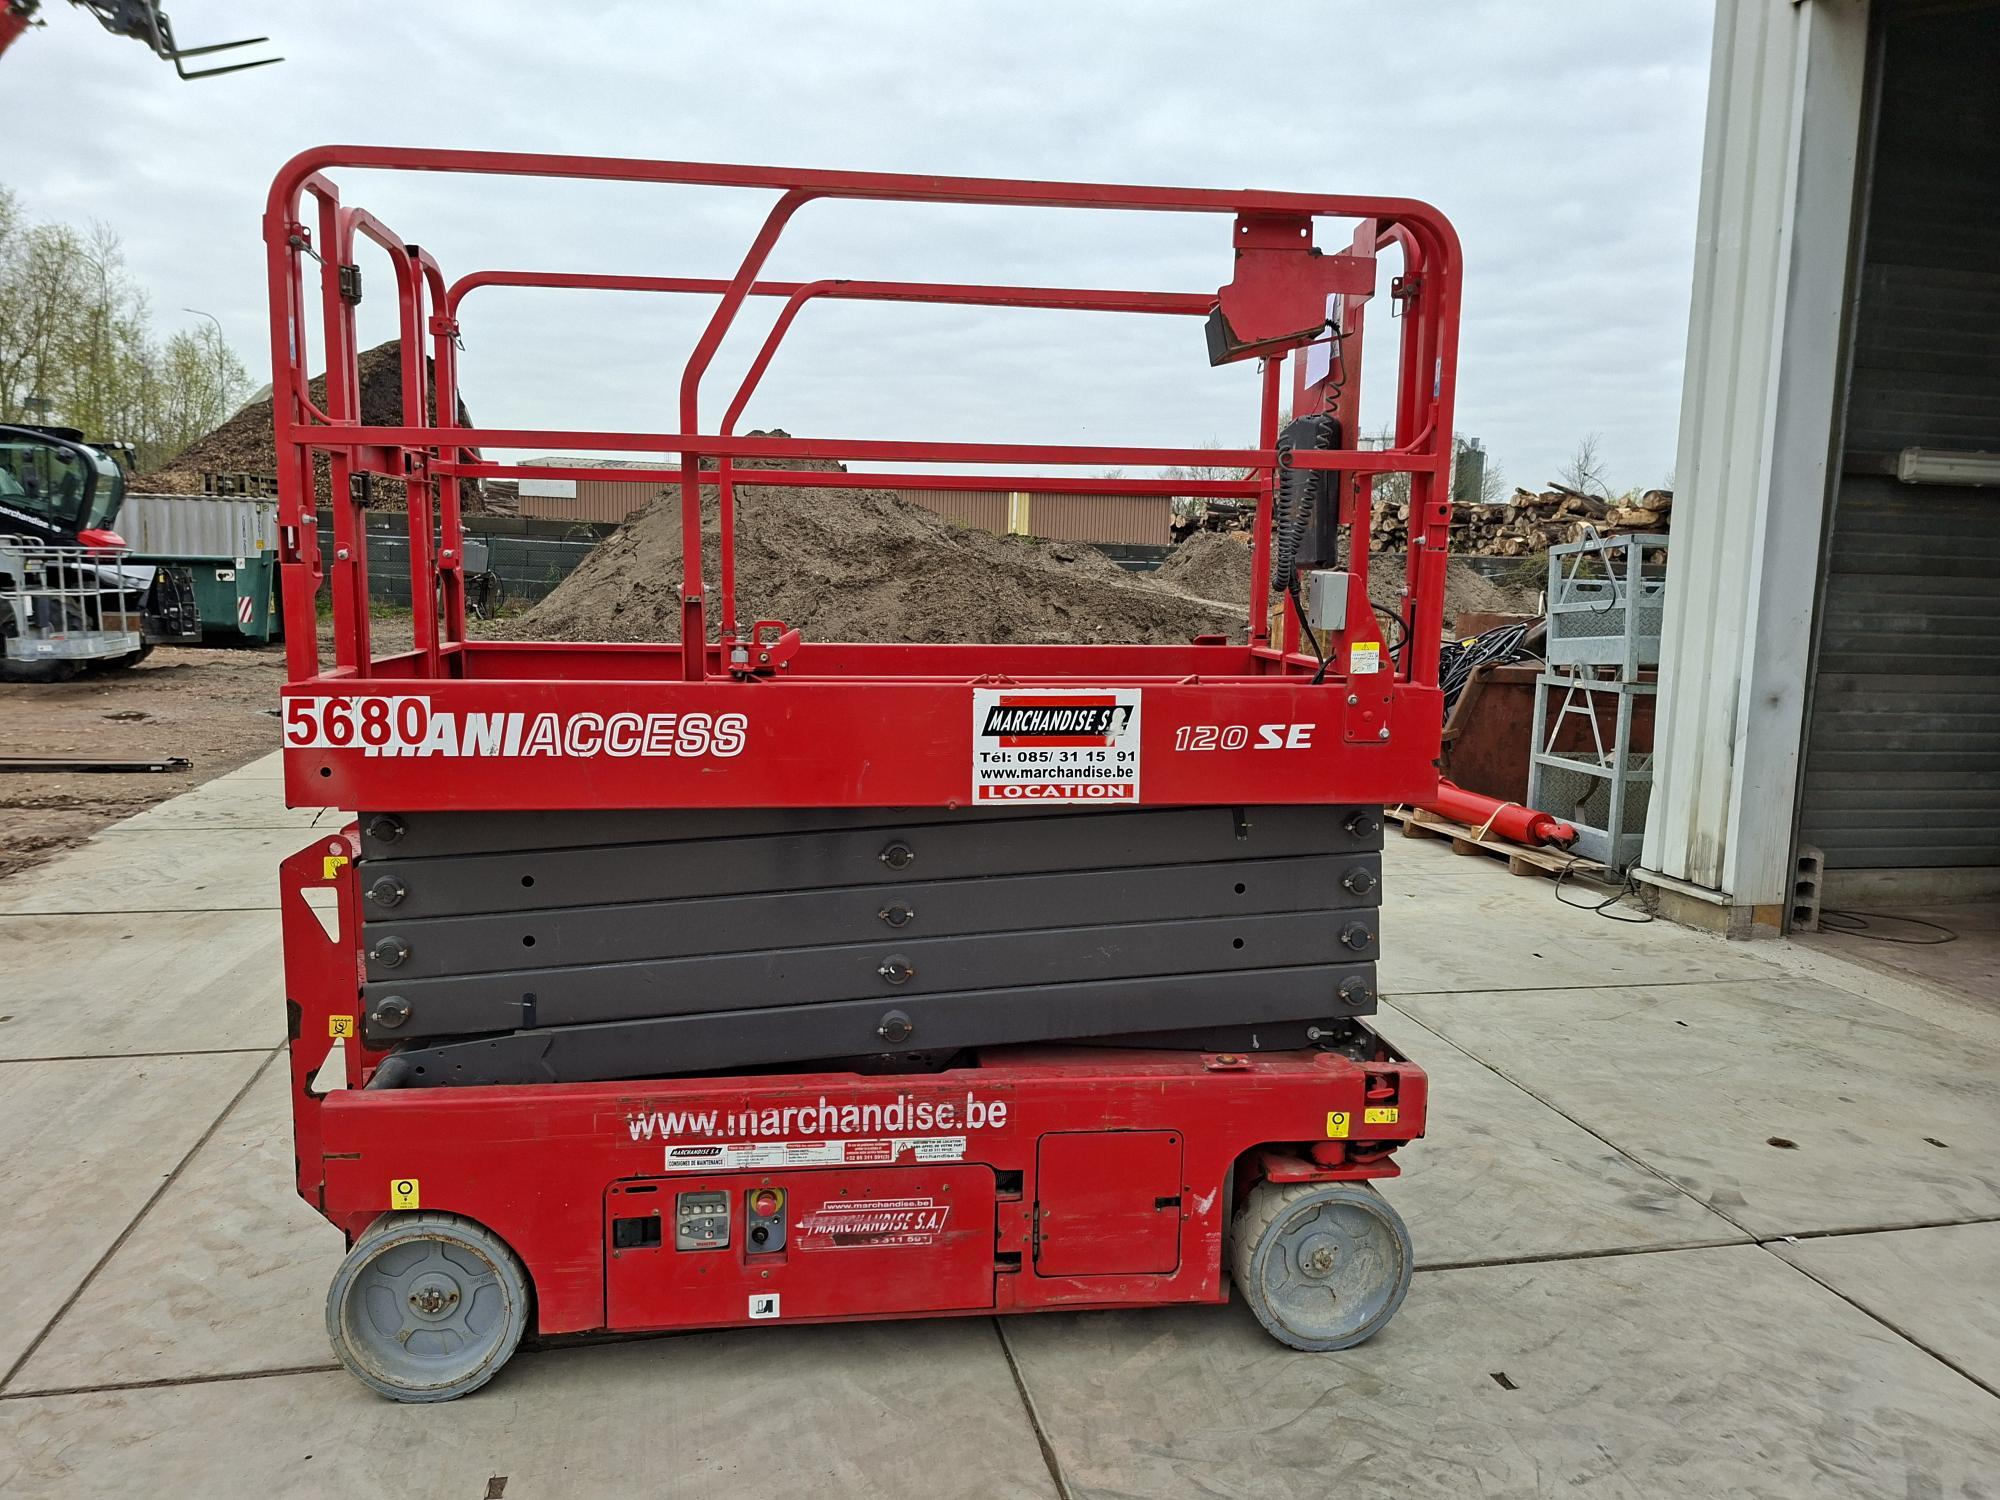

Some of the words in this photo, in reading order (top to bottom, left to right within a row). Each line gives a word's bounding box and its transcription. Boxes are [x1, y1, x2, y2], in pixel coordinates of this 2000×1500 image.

[287, 697, 428, 746] 5680
[987, 709, 1097, 731] MARCHANDISE
[365, 712, 748, 757] ANIACCESS
[1175, 725, 1249, 751] 120
[1253, 723, 1316, 750] SE
[980, 751, 1012, 763] Tél:
[1017, 751, 1054, 763] 085/
[1059, 751, 1078, 762] 31
[1086, 751, 1106, 762] 15
[1116, 751, 1135, 762] 91
[980, 765, 1134, 779] www.marchandise.be
[988, 784, 1125, 798] LOCATION
[626, 1091, 1007, 1141] www.marchandise.be
[827, 1200, 930, 1210] www.marchandise.be
[914, 1211, 939, 1231] S.A.
